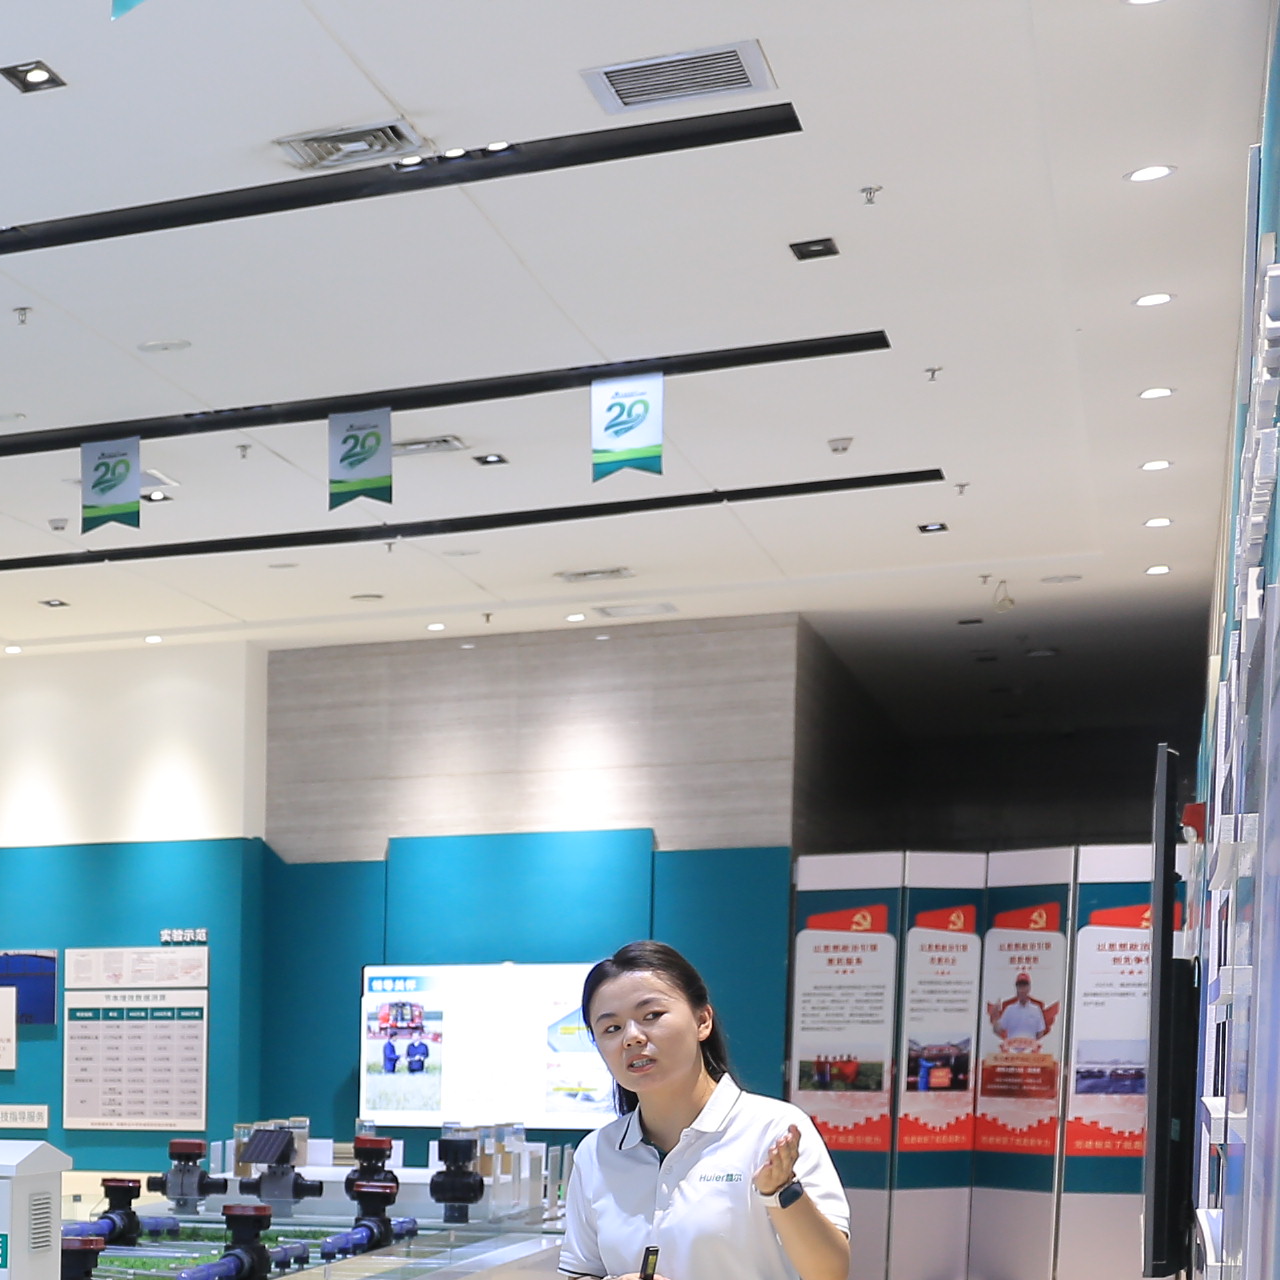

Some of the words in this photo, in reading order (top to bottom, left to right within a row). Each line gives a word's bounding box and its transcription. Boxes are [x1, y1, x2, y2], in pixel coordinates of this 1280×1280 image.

[604, 399, 649, 435] 20
[339, 431, 381, 468] 20
[92, 459, 130, 493] 20
[160, 928, 208, 943] 实验示范
